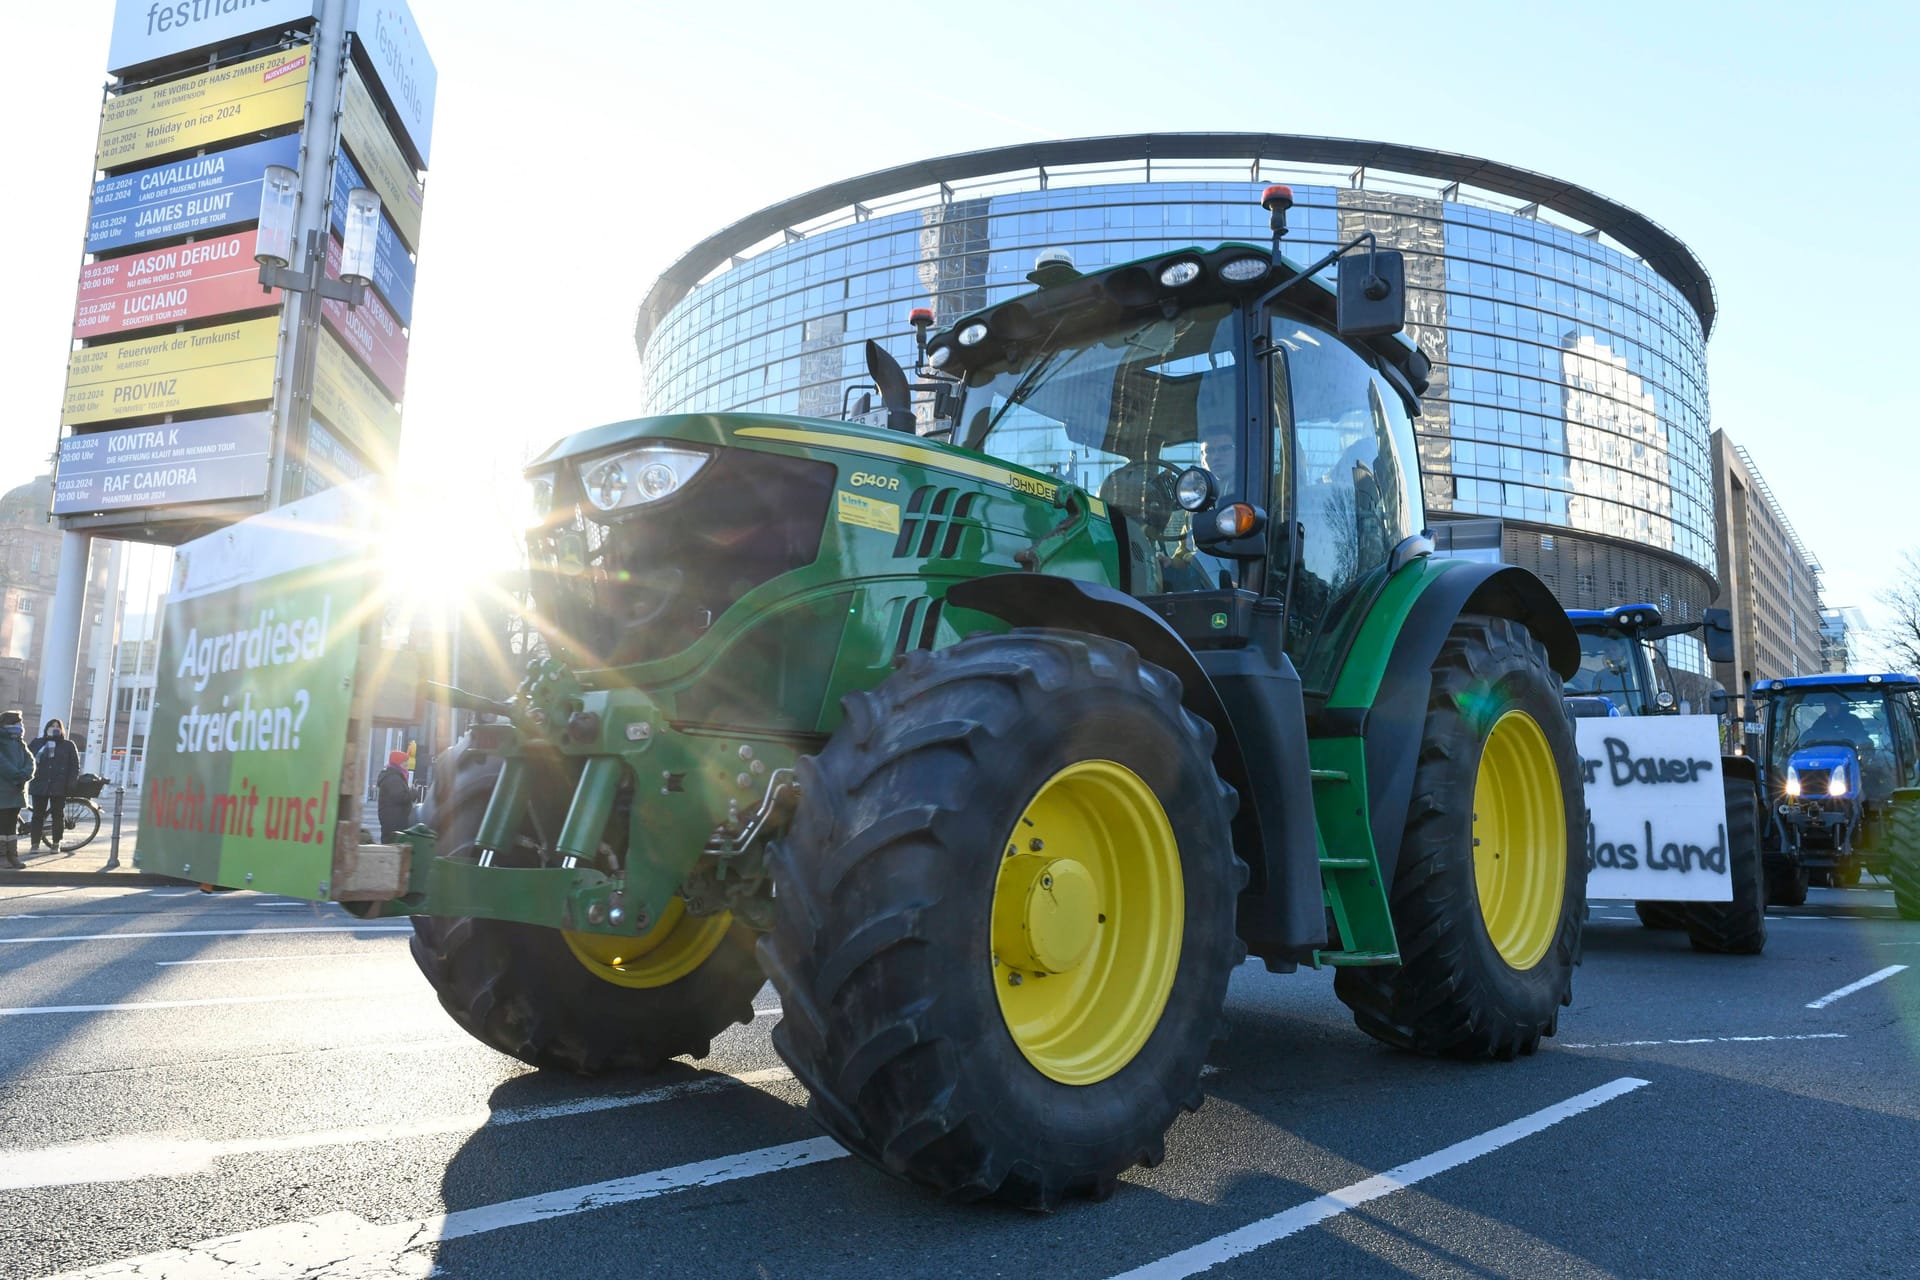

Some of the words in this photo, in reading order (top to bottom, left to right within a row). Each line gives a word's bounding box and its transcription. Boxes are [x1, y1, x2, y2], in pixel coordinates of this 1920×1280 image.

[146, 0, 271, 36] festha
[264, 58, 305, 80] AUSVERKAUFT
[376, 9, 422, 124] festhalle
[153, 90, 167, 100] THE
[169, 82, 196, 96] WORLD
[198, 78, 208, 87] OF
[209, 72, 231, 85] HANS
[232, 63, 265, 78] ZIMMER
[267, 57, 286, 70] 2024
[108, 95, 143, 110] 15.03.2024
[156, 98, 170, 107] NEW
[172, 90, 206, 105] DIMENSION
[106, 110, 124, 122] 20:00
[126, 108, 138, 116] Uhr
[146, 121, 182, 138] Holiday
[184, 118, 196, 128] on
[200, 113, 214, 124] ice
[216, 104, 242, 120] 2024
[104, 132, 137, 147] 10.01.2024
[145, 141, 154, 149] NO
[154, 136, 175, 147] LIMITS
[102, 143, 136, 158] 14.01.2024
[140, 157, 225, 191] CAVALLUNA
[96, 178, 132, 194] 02.02.2024
[138, 193, 154, 202] LAND
[156, 189, 168, 198] DER
[170, 183, 197, 196] TAUSEND
[198, 176, 224, 188] TRÄUME
[95, 190, 131, 205] 04.02.2024
[135, 204, 183, 228] JAMES
[186, 192, 234, 216] BLUNT
[92, 216, 127, 230] 14.03.2024
[134, 230, 146, 239] THE
[162, 224, 172, 232] WE
[174, 221, 190, 230] USED
[191, 218, 199, 227] TO
[200, 216, 208, 225] BE
[210, 213, 226, 222] TOUR
[90, 230, 109, 240] 20:00
[110, 228, 122, 238] Uhr
[128, 252, 176, 278] JASON
[181, 239, 240, 266] DERULO
[84, 264, 120, 278] 19.03.2024
[127, 280, 136, 288] NU
[137, 276, 152, 286] KING
[152, 273, 175, 284] WORLD
[176, 269, 192, 280] TOUR
[82, 279, 101, 290] 20:00
[102, 278, 115, 286] Uhr
[124, 288, 188, 315] LUCIANO
[78, 316, 96, 328] 20:00
[98, 314, 110, 324] Uhr
[122, 314, 154, 327] SEDUCTIVE
[156, 310, 171, 320] TOUR
[172, 308, 188, 318] 2024
[371, 298, 394, 337] DERULO
[346, 310, 373, 352] LUCIANO
[118, 341, 168, 360] Feuerwerk
[171, 339, 187, 351] der
[191, 330, 241, 347] Turnkunst
[72, 366, 90, 376] 19:00
[92, 364, 104, 373] Uhr
[117, 359, 150, 370] HEARTBEAT
[114, 379, 178, 403] PROVINZ
[66, 404, 86, 414] 20:00
[87, 403, 100, 412] Uhr
[148, 402, 164, 410] TOUR
[166, 399, 180, 408] 2024
[64, 438, 99, 450] 16.03.2024
[108, 431, 164, 453] KONTRA
[168, 428, 180, 446] K
[61, 453, 80, 462] 20:00
[81, 452, 94, 460] Uhr
[106, 456, 116, 464] DIE
[117, 452, 150, 464] HOFFNUNG
[152, 449, 172, 460] KLAUT
[172, 448, 185, 457] MIR
[186, 444, 217, 456] NIEMAND
[218, 442, 236, 452] TOUR
[58, 478, 93, 490] 17.03.2024
[104, 474, 130, 492] RAF
[133, 468, 198, 490] CAMORA
[1006, 473, 1035, 494] JOHN
[56, 492, 75, 502] 20:00
[76, 490, 90, 500] Uhr
[102, 494, 132, 504] PHANTOM
[133, 492, 150, 502] TOUR
[151, 491, 166, 500] 2024
[176, 594, 332, 692] Agrardiesel
[176, 689, 310, 754] streichen?
[1604, 736, 1713, 787] Bauer
[147, 776, 206, 832] Nicht
[209, 778, 259, 838] mit
[264, 780, 331, 845] uns!
[1645, 820, 1727, 875] Land
